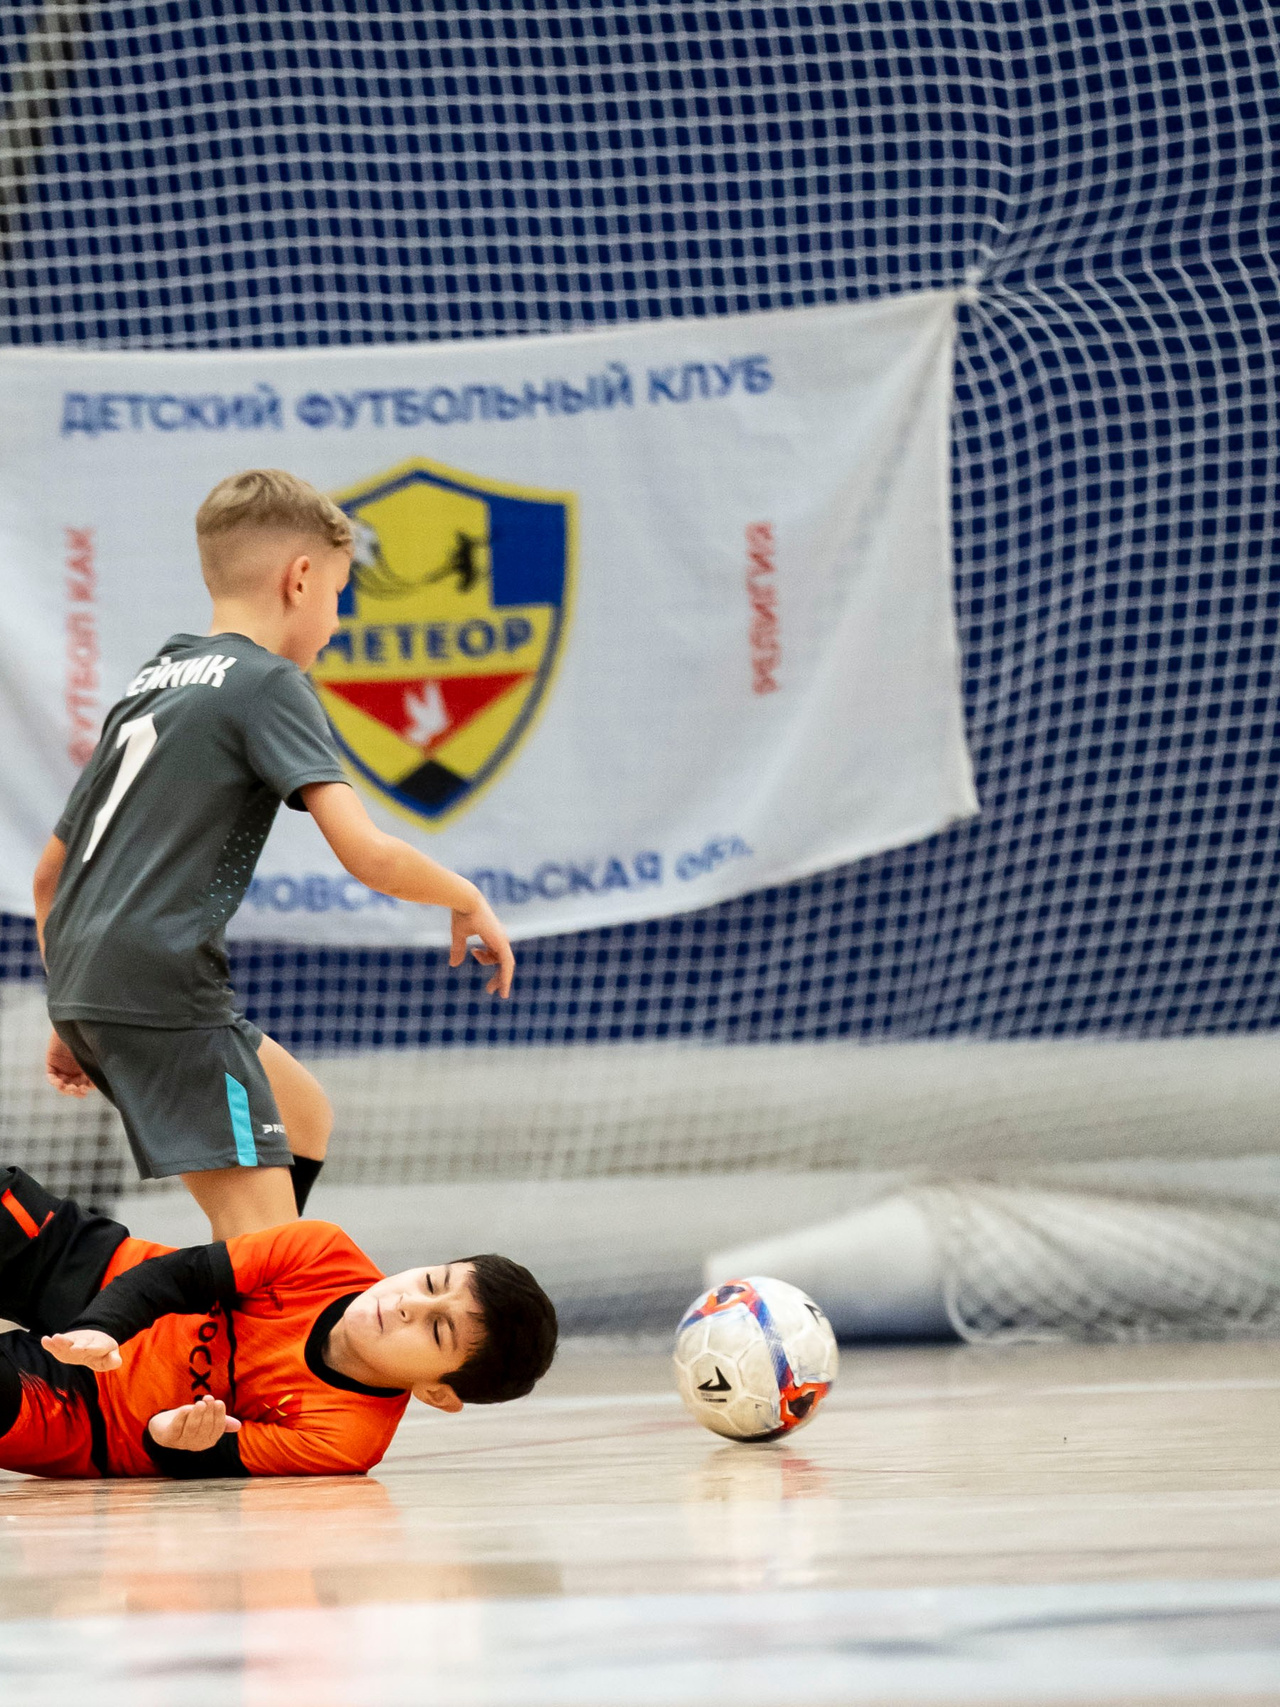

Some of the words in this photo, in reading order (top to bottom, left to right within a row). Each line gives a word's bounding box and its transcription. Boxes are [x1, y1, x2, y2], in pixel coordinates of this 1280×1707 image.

[62, 383, 282, 437] ДЕТСКИЙ
[296, 361, 632, 428] ФУТБОЛЬНЫЙ
[648, 355, 773, 404] КЛУБ
[66, 525, 96, 602] КАК
[316, 618, 532, 664] МЕТЕОР
